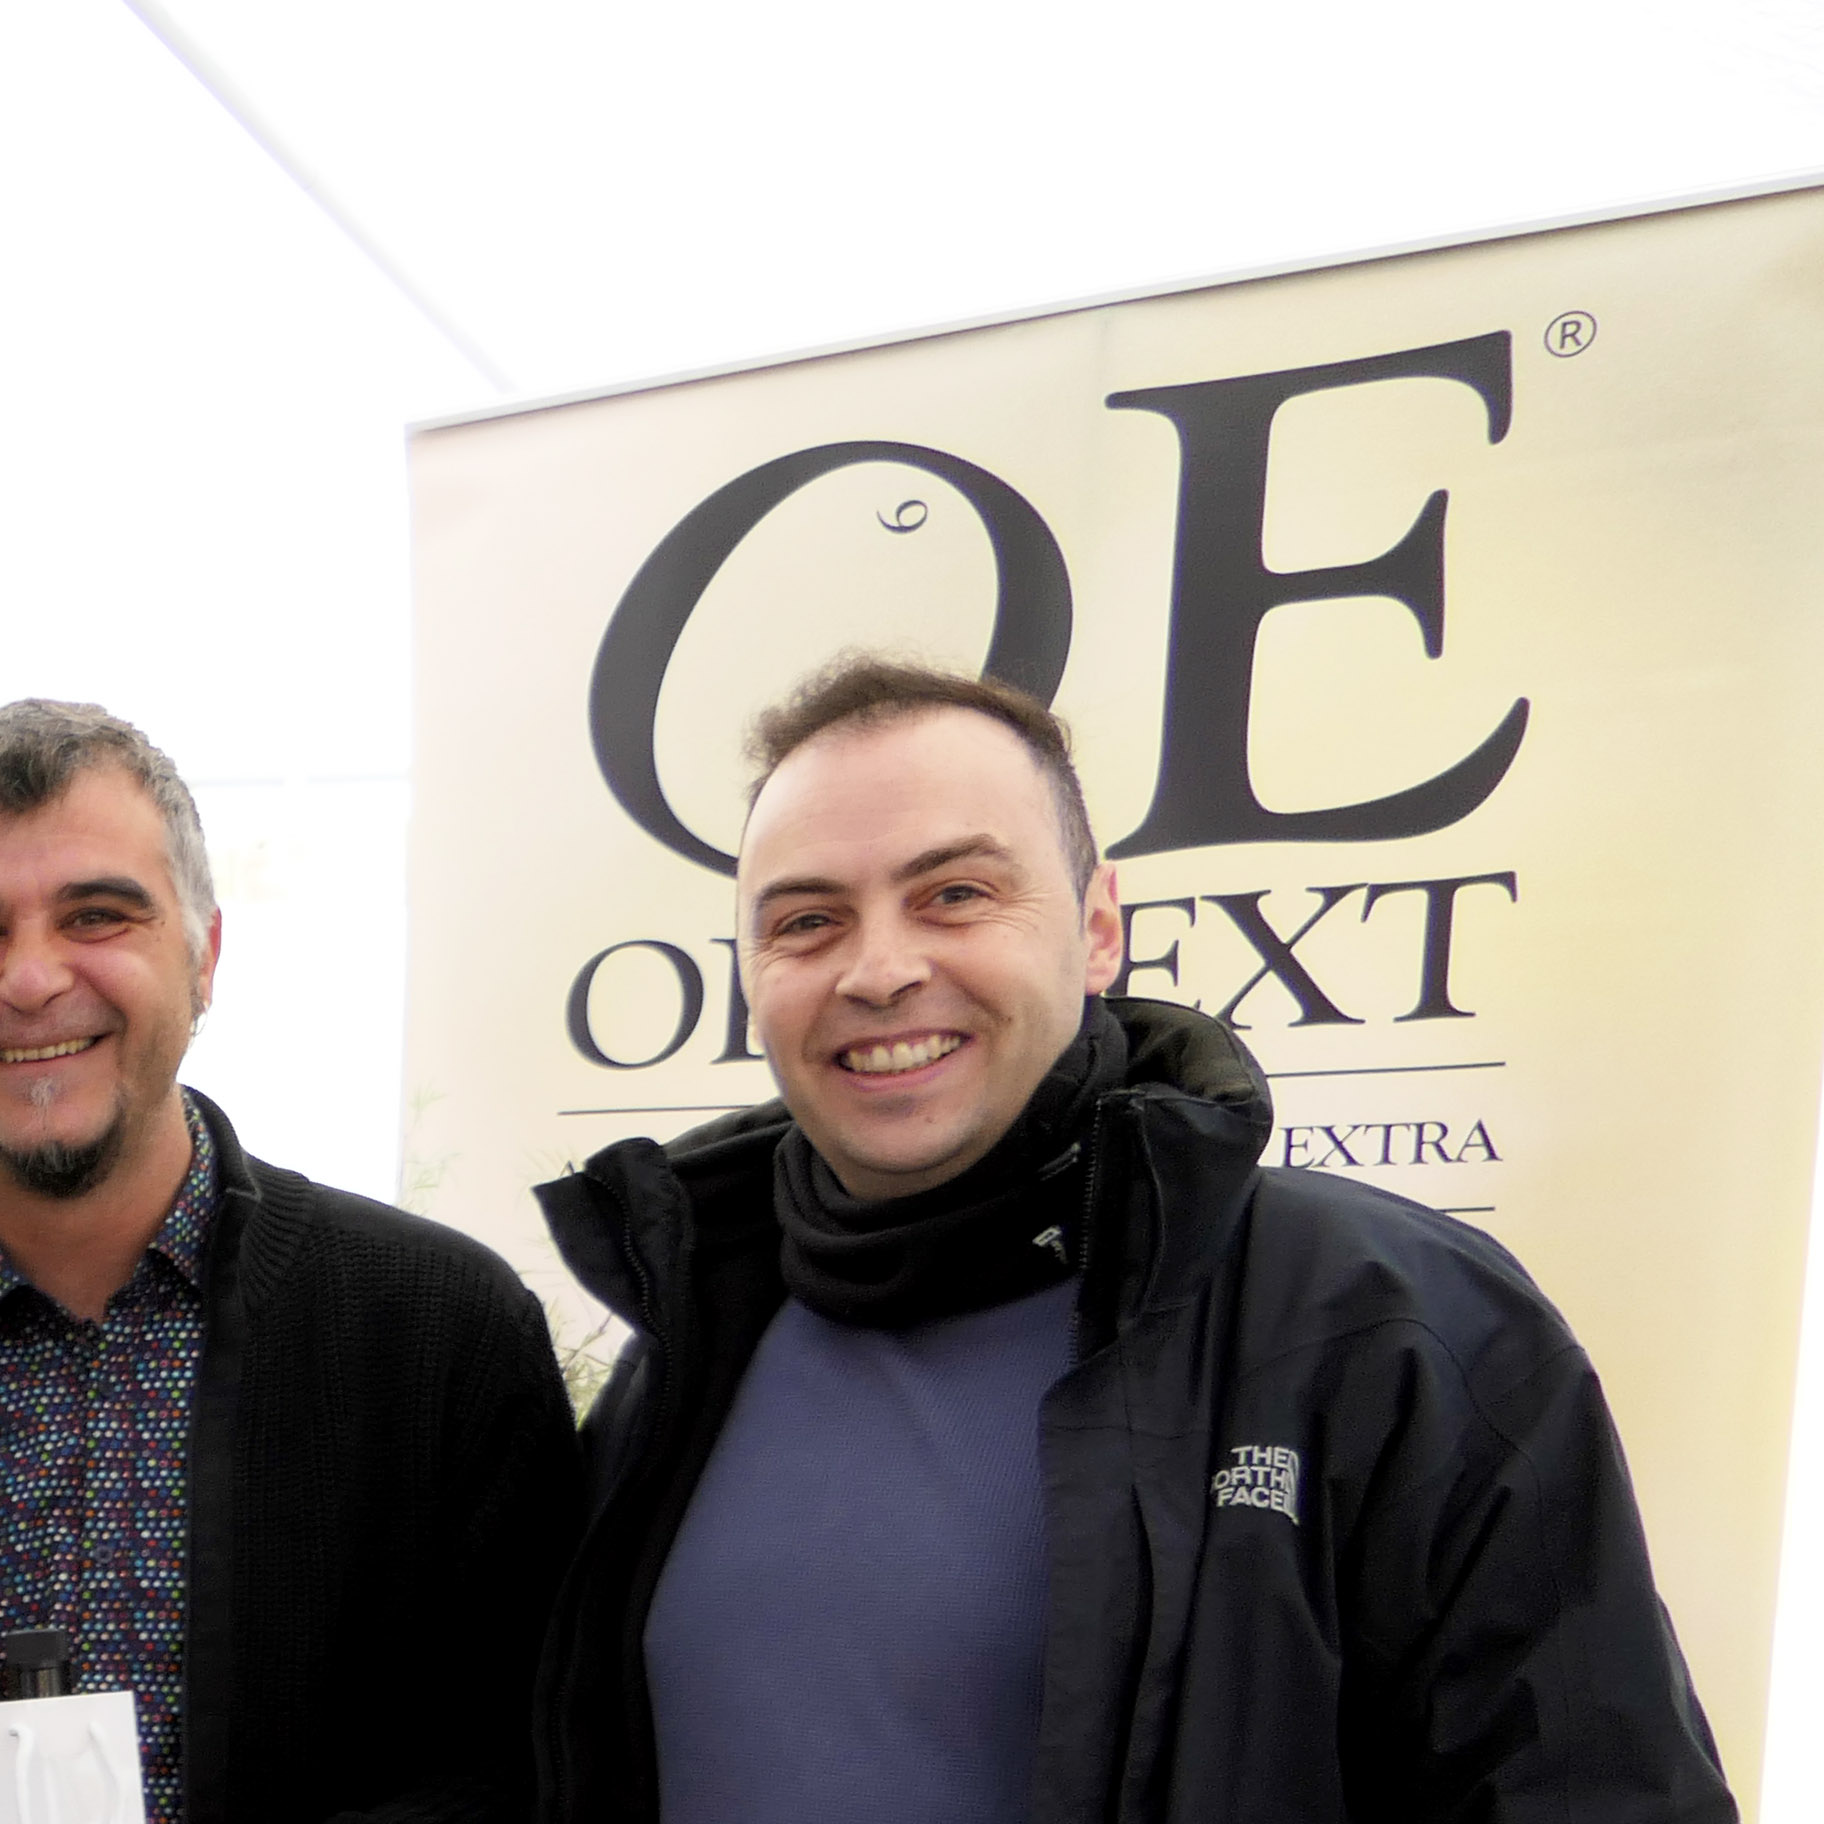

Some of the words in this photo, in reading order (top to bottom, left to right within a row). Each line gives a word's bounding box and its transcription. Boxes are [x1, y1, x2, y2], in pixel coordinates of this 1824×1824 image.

[589, 329, 1530, 878] OE
[1279, 1119, 1503, 1168] EXTRA
[1231, 1446, 1290, 1468] THE
[1211, 1466, 1288, 1494] ORTH
[1216, 1487, 1287, 1512] FACE
